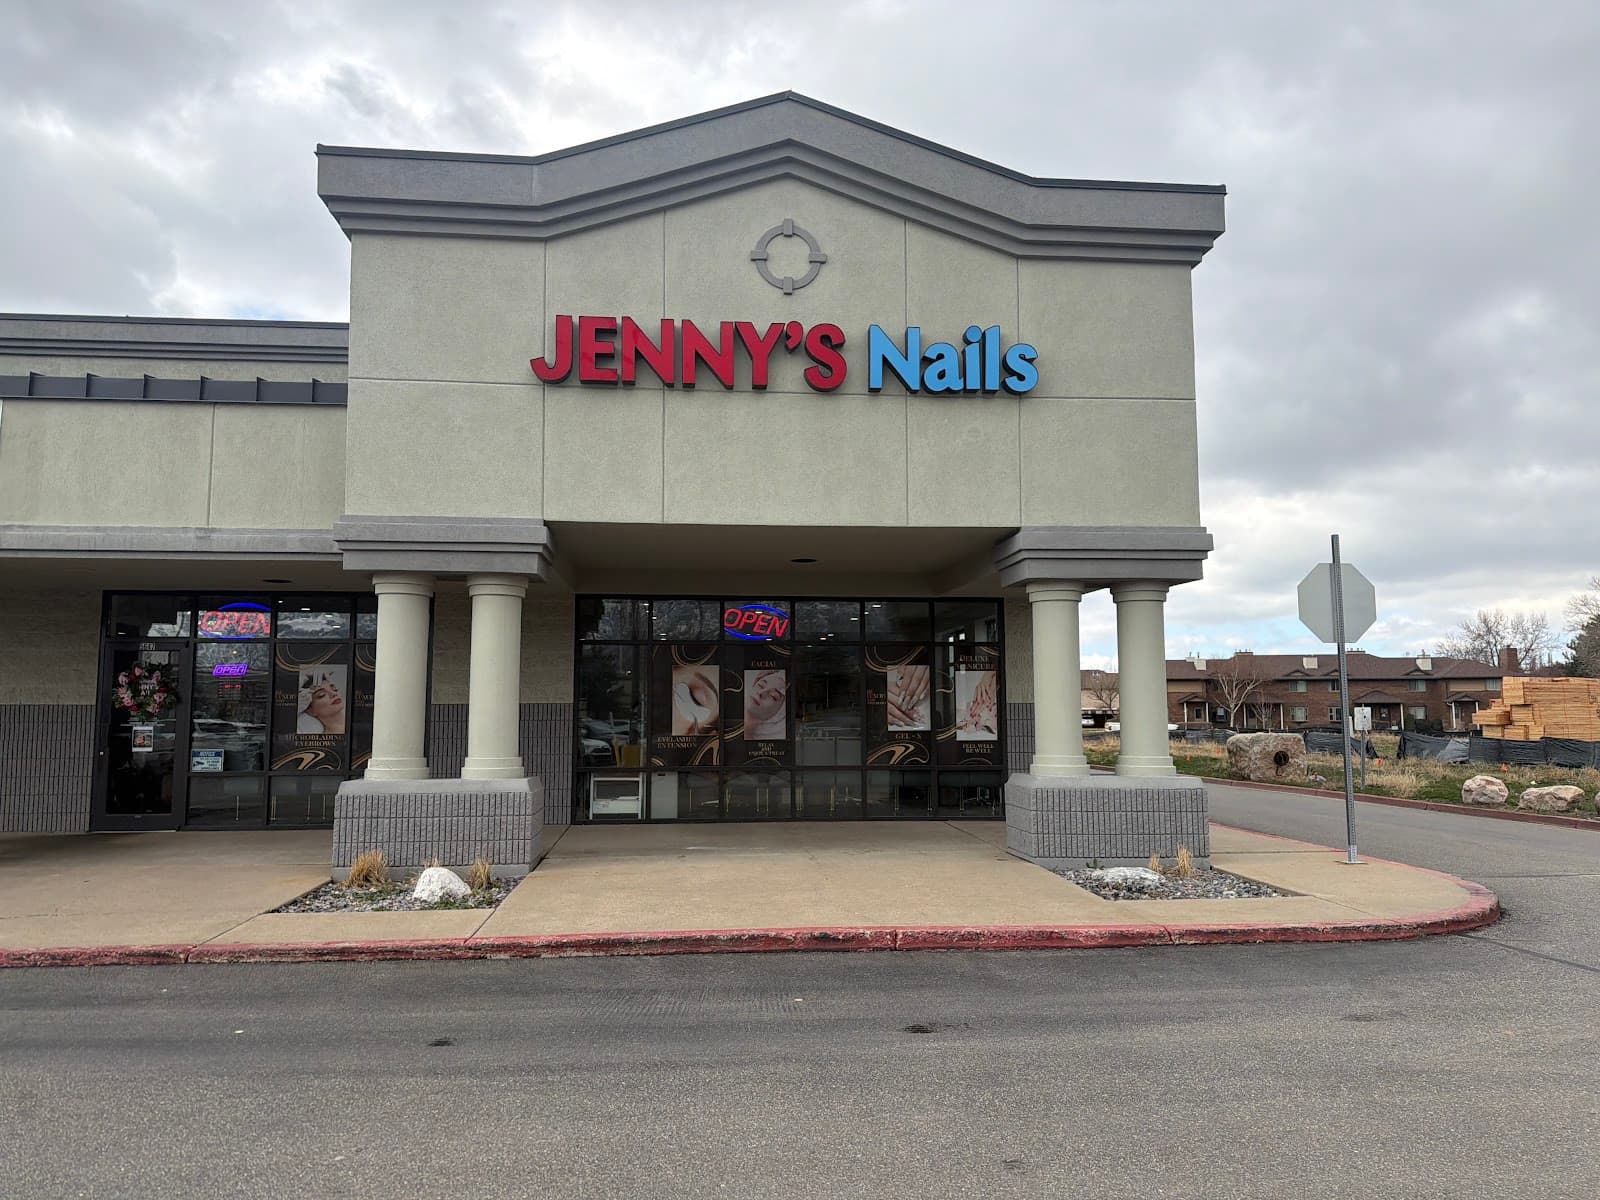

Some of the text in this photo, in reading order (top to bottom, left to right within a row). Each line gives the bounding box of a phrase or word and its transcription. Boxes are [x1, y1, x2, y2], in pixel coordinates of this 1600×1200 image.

[530, 315, 1039, 397] JENNY'S Nails
[200, 610, 271, 636] OPEN
[724, 608, 789, 637] OPEN
[215, 665, 246, 674] OPEN
